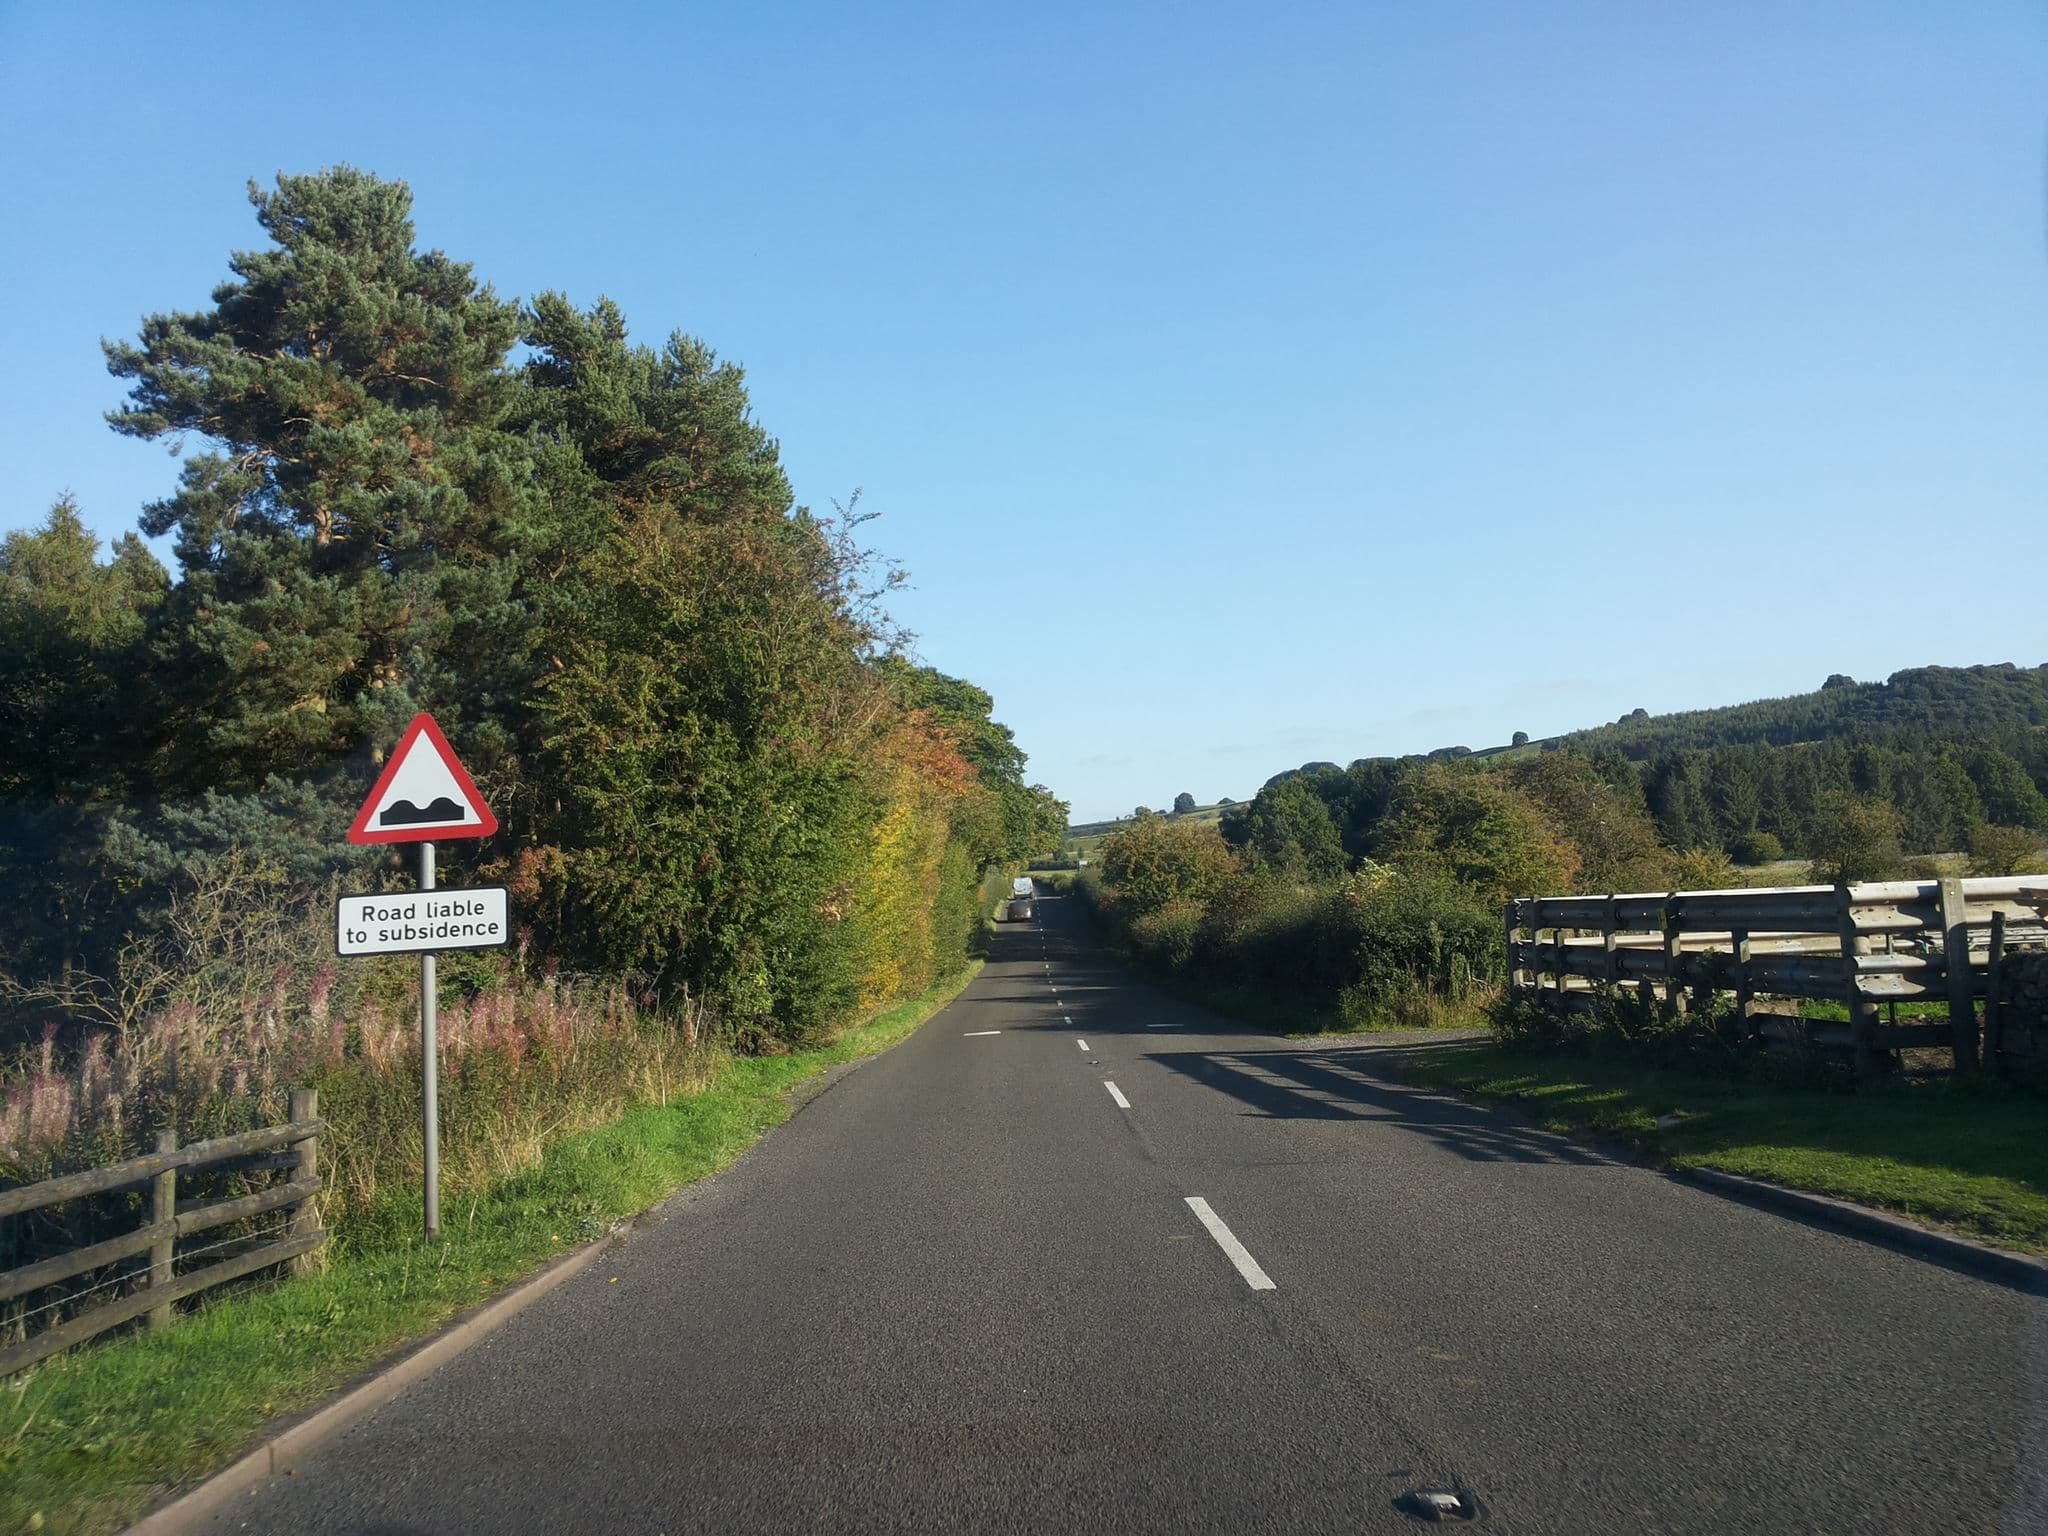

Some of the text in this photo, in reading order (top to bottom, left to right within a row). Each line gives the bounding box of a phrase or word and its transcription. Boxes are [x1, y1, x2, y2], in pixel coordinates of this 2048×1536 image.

[362, 900, 485, 922] Road liable
[346, 922, 499, 944] to subsidence
